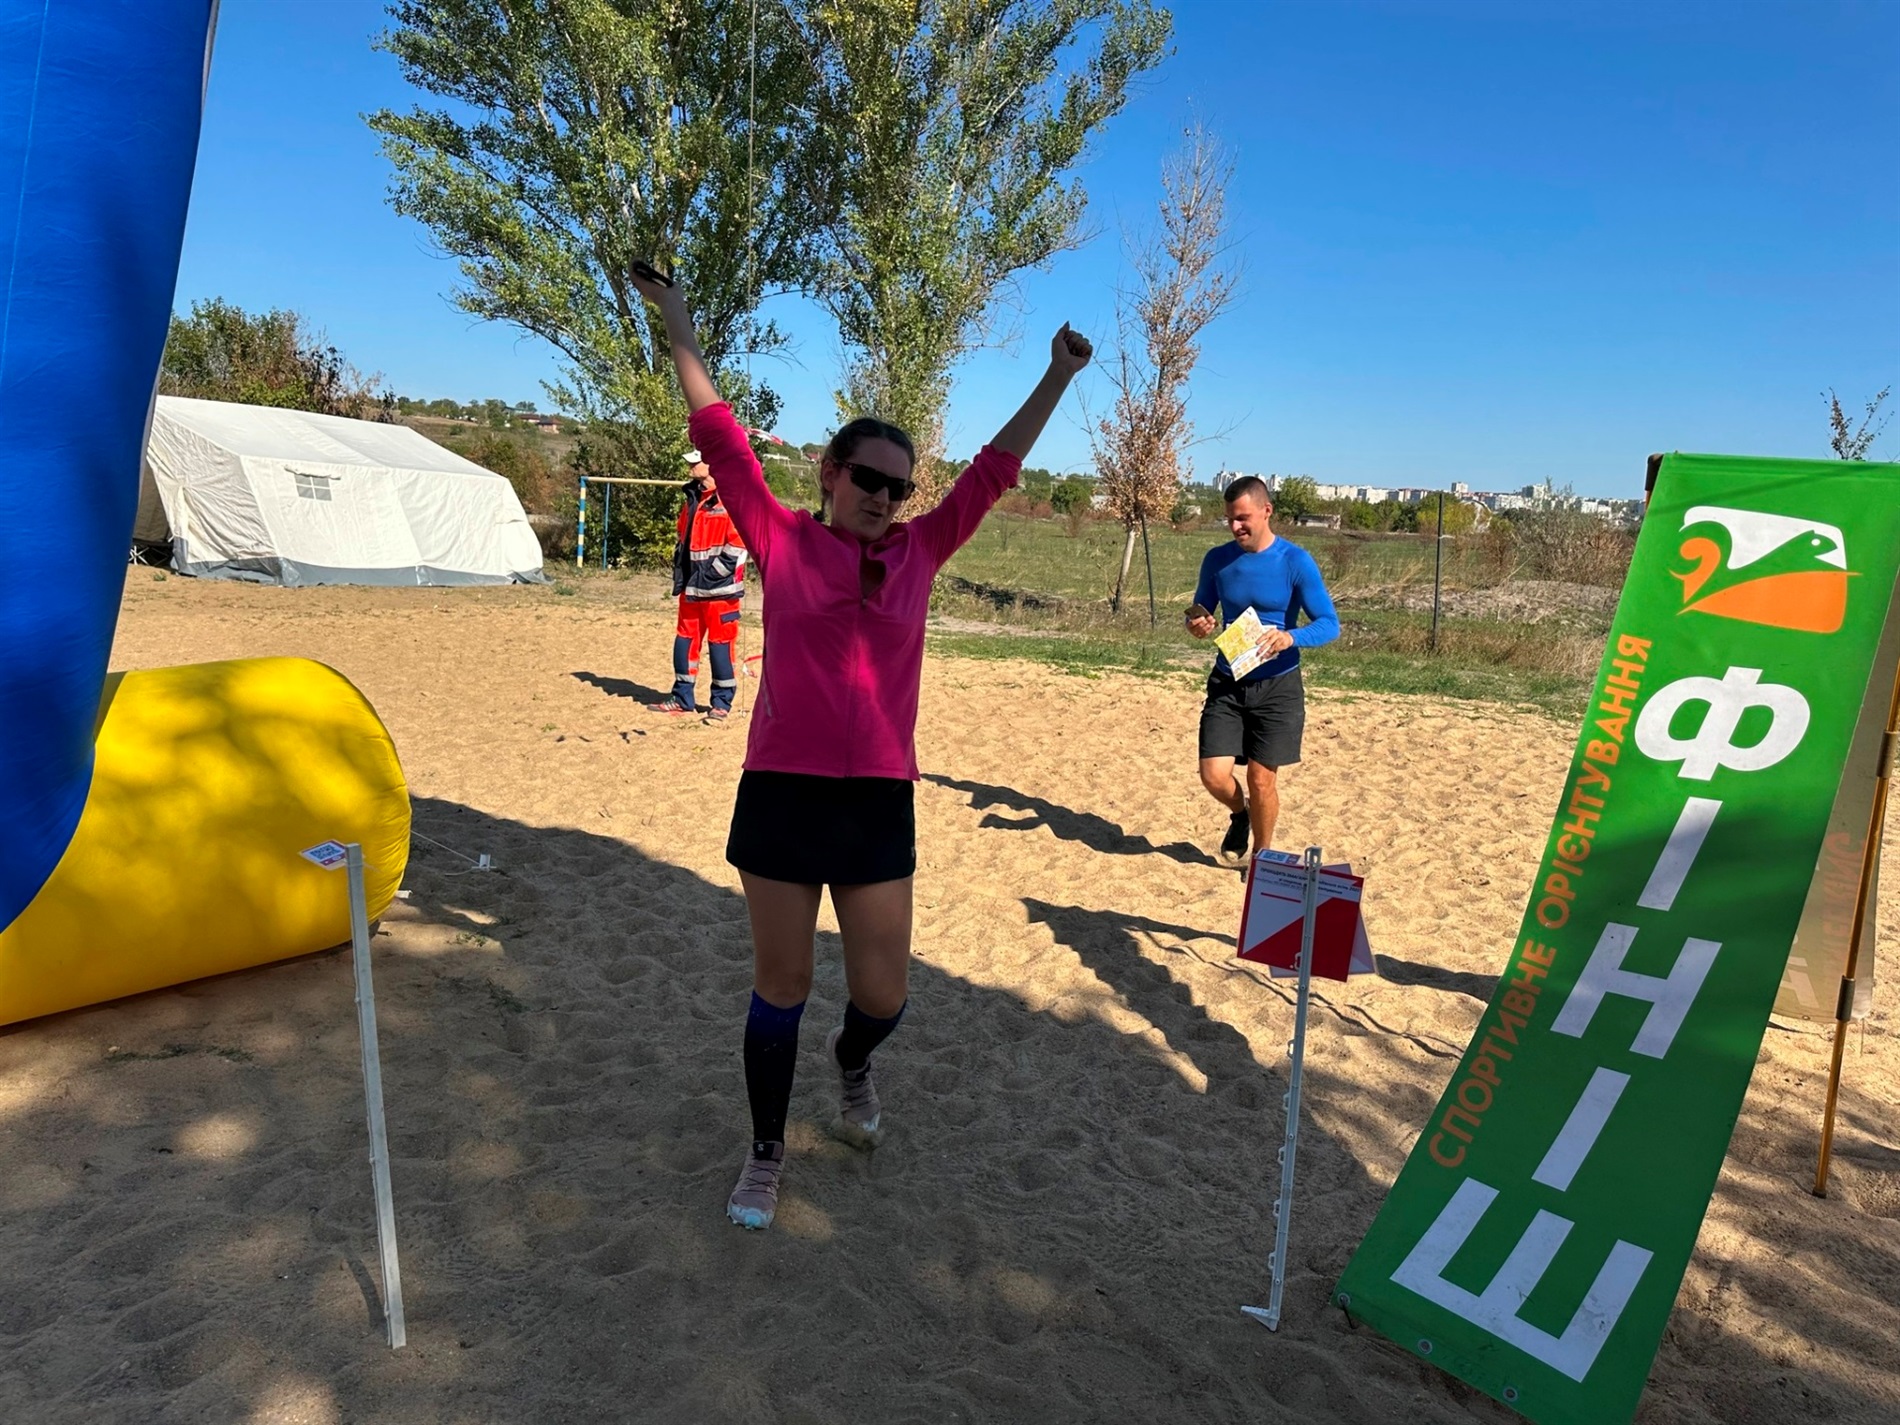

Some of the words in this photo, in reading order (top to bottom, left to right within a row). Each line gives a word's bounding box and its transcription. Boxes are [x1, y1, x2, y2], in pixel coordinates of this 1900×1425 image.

[1390, 666, 1811, 1383] ФІНІШ
[1428, 939, 1557, 1168] СПОРТИВНЕ
[1536, 634, 1653, 930] ОРІЄНТУВАННЯ
